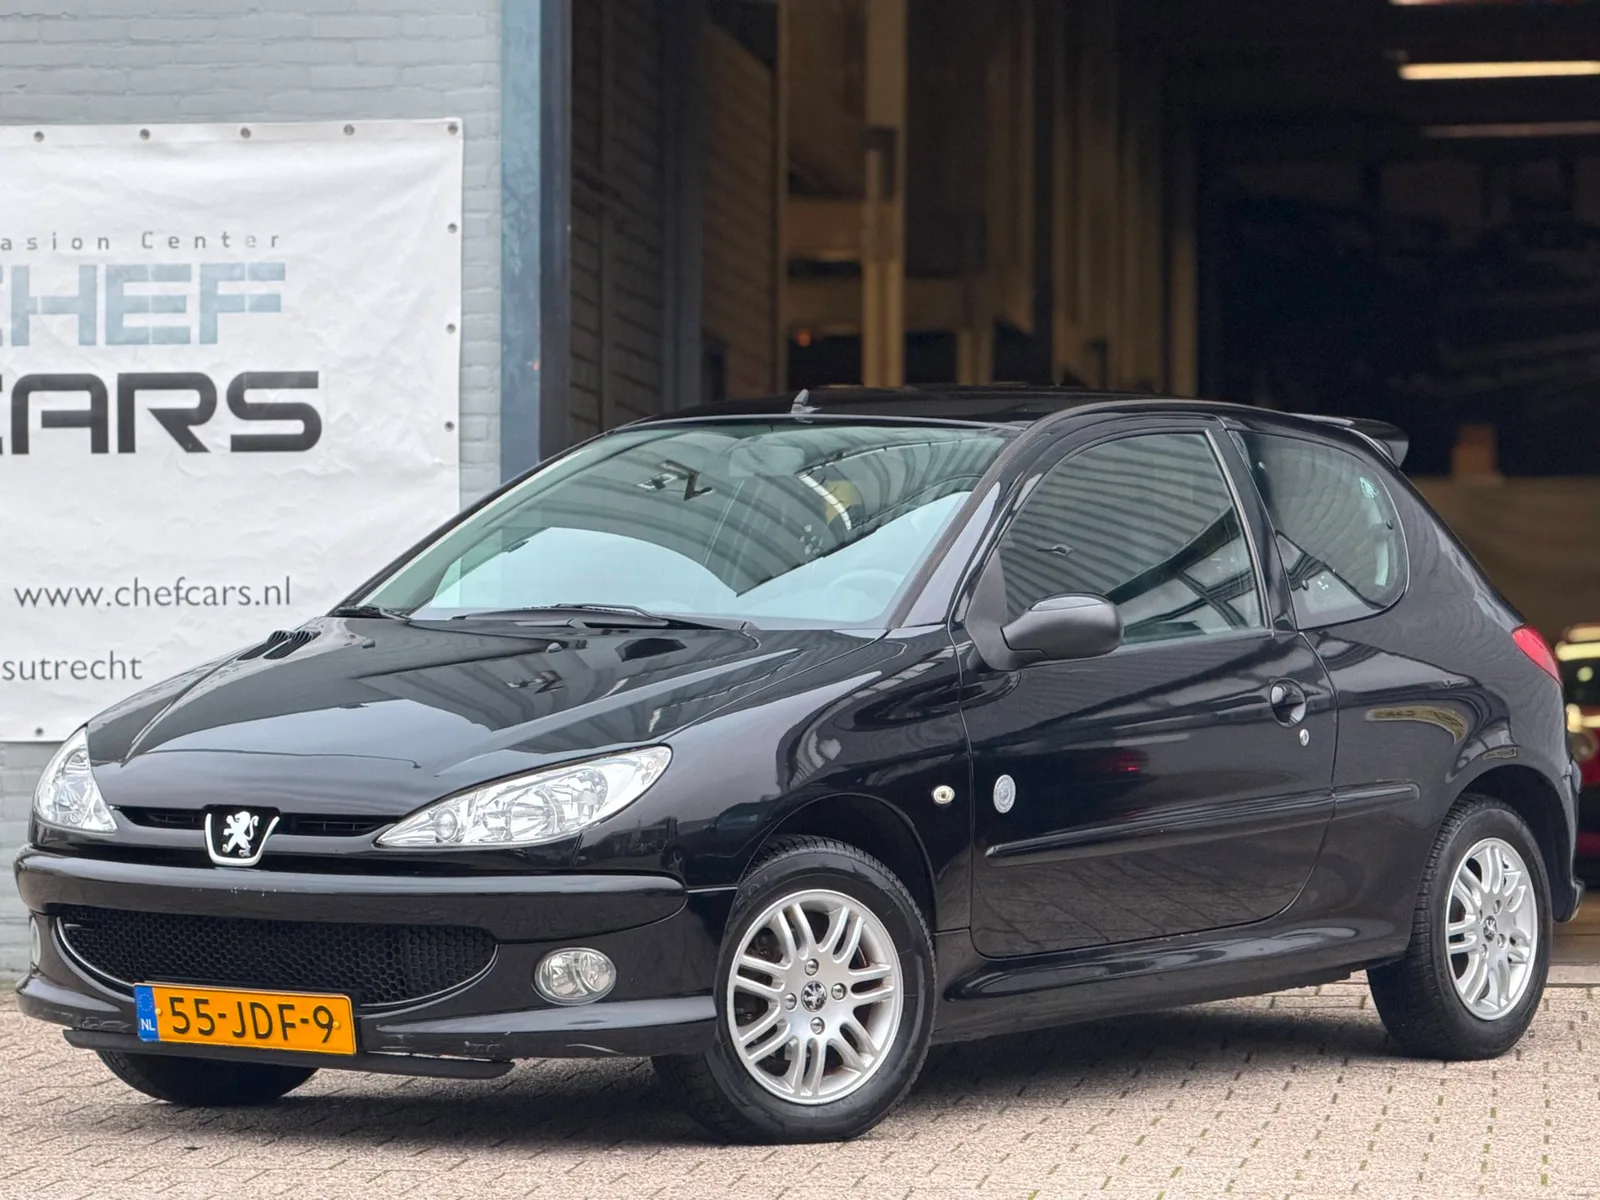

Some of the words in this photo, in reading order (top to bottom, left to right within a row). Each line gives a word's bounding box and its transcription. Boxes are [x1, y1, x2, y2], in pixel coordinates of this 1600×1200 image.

[0, 231, 110, 251] asion
[141, 231, 280, 250] Center
[0, 263, 286, 346] HEF
[0, 371, 322, 455] ARS
[14, 576, 291, 608] www.chefcars.nl
[2, 651, 143, 681] sutrecht
[140, 1018, 157, 1032] NL
[168, 996, 335, 1043] 55-JDF-9
